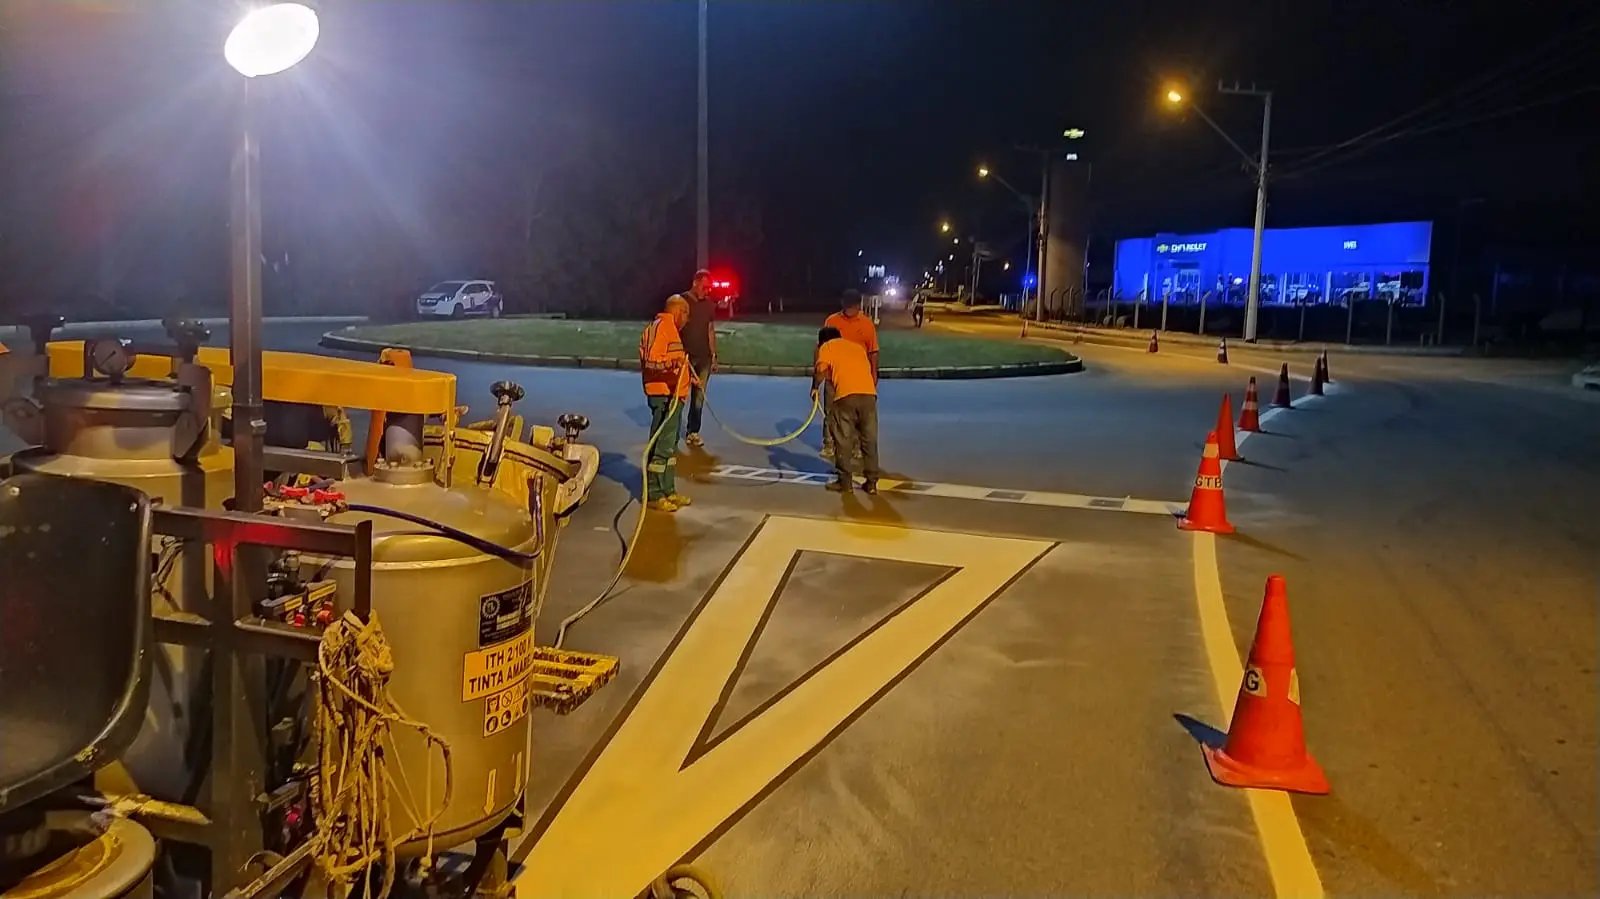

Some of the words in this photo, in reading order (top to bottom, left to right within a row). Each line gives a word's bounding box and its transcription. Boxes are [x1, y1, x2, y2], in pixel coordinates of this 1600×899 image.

[1195, 475, 1222, 488] GTB
[486, 650, 504, 670] ITH
[469, 670, 503, 693] TINTA
[1245, 670, 1259, 691] G
